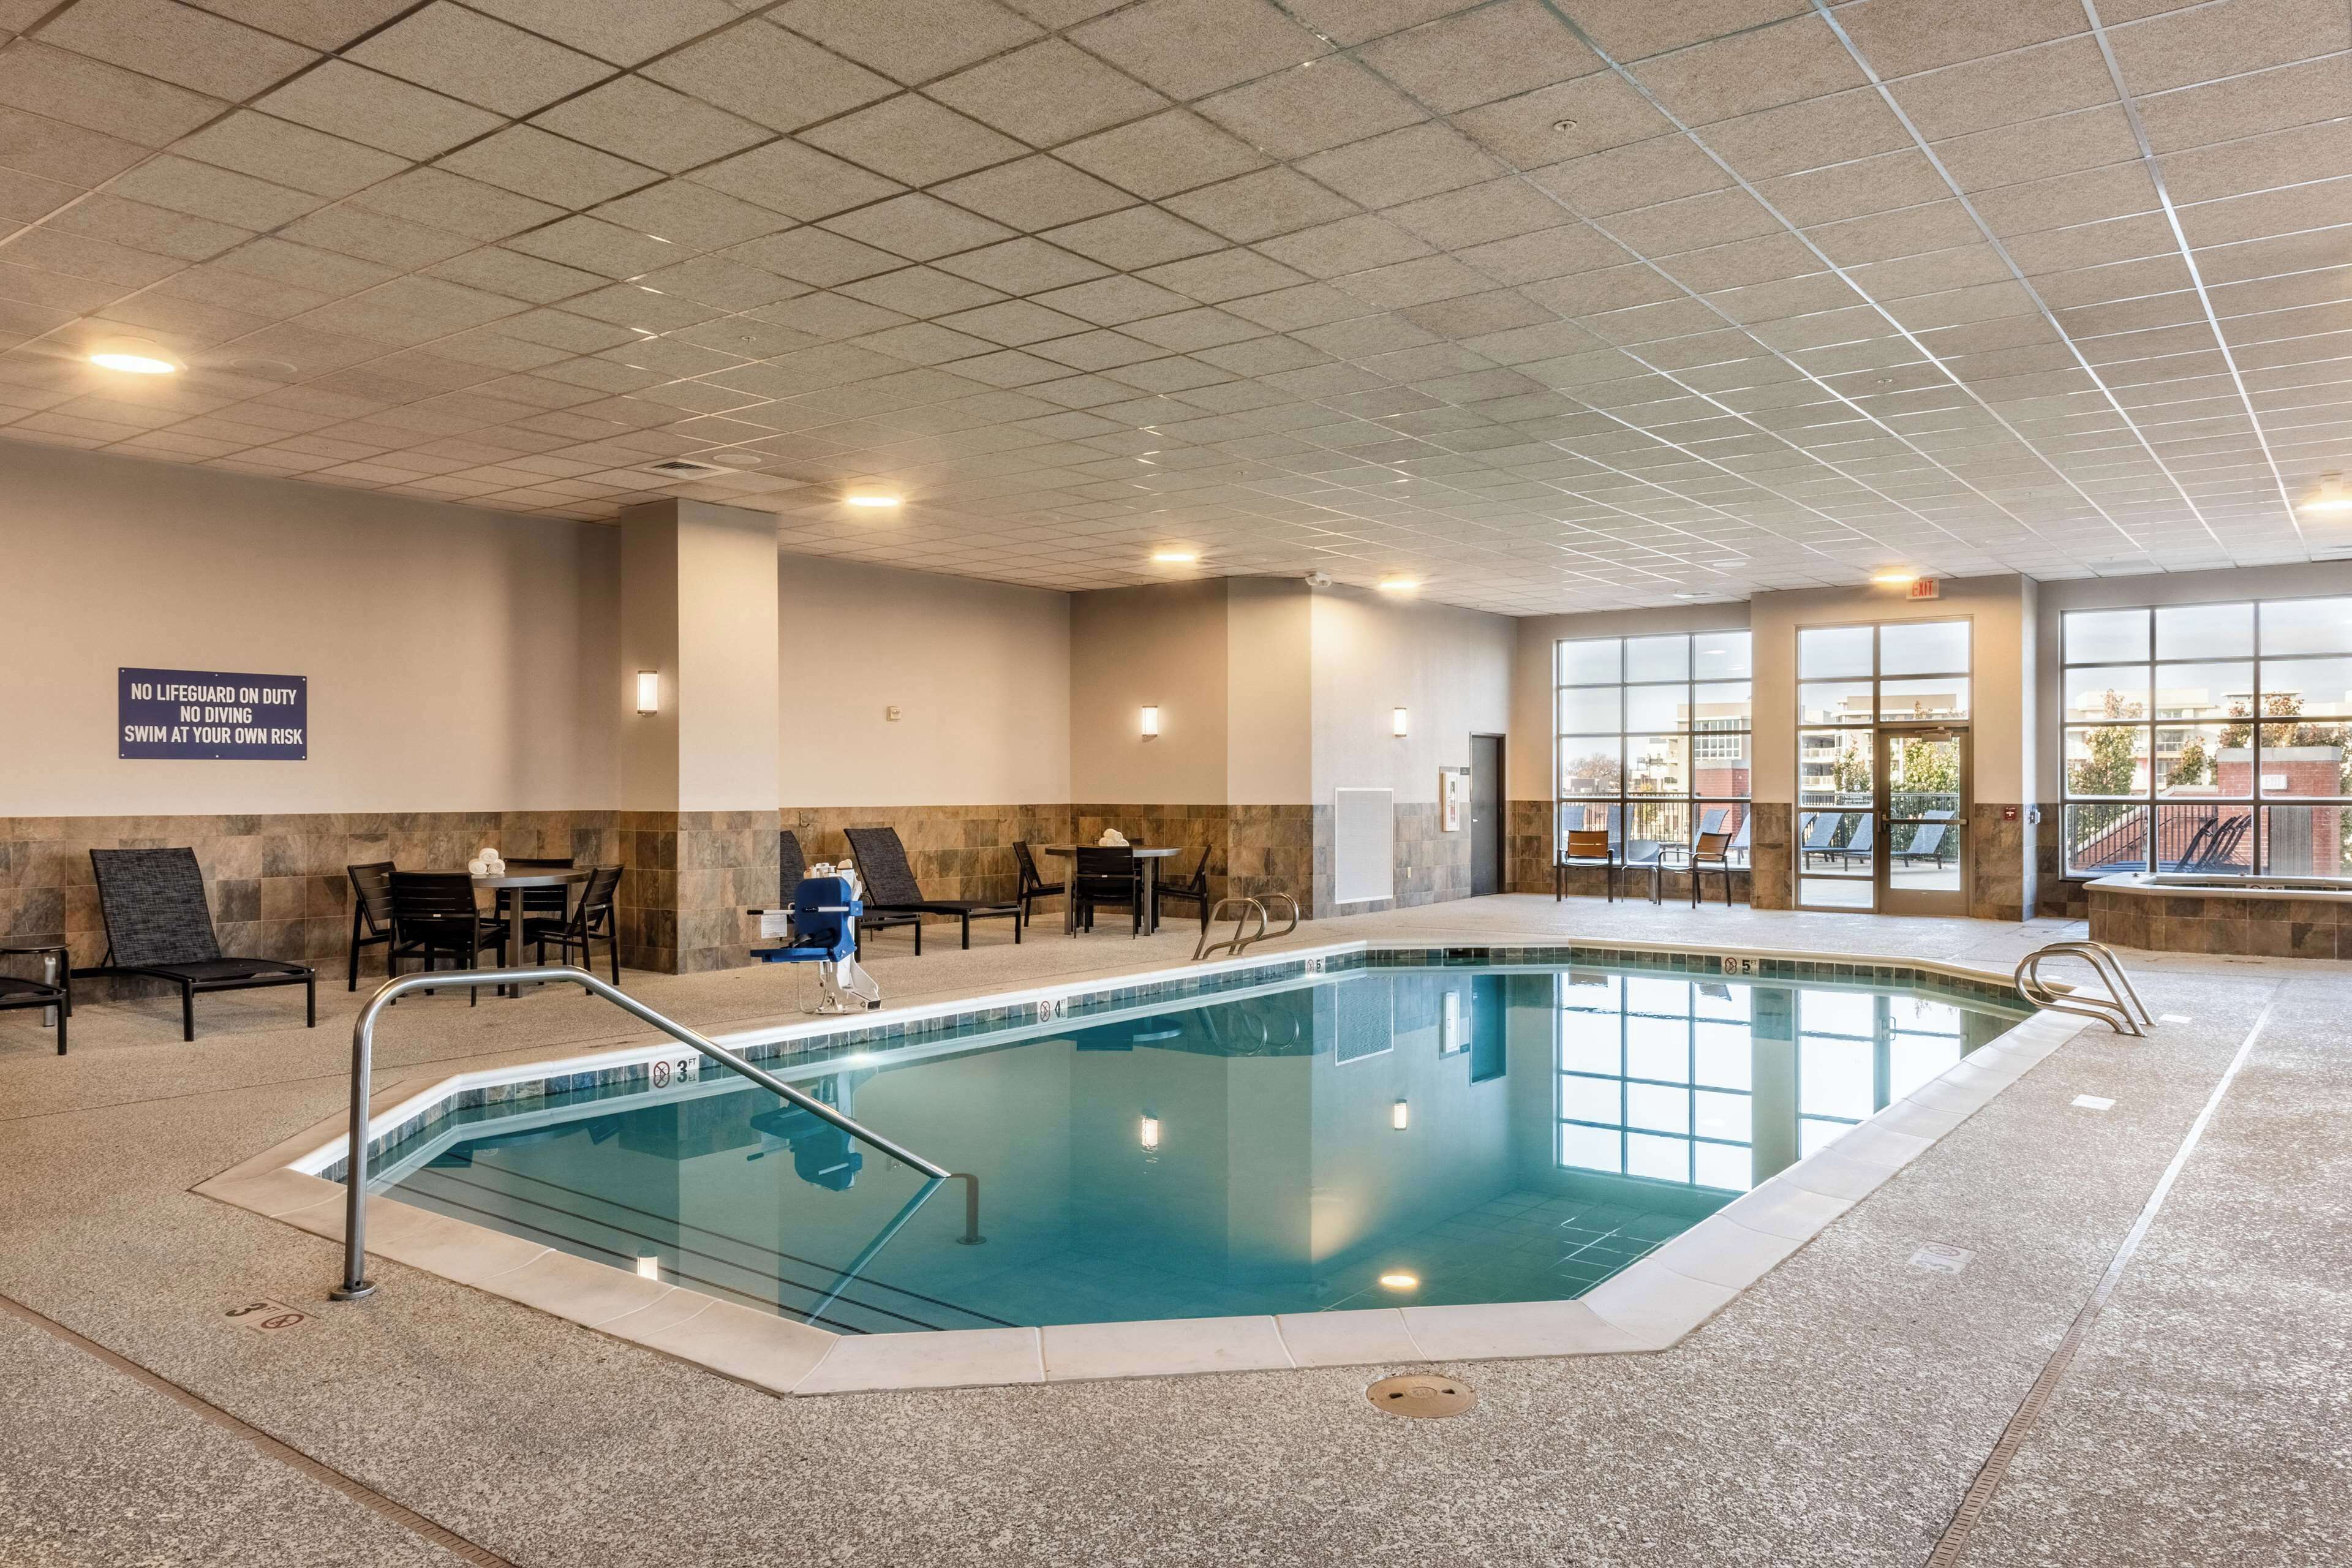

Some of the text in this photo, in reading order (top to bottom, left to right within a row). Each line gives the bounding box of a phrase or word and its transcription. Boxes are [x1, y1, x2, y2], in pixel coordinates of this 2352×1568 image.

[1911, 579, 1934, 597] EXIT
[131, 683, 297, 705] NO LIFEGUARD ON DUTY
[181, 706, 252, 724] NO DIVING
[124, 725, 303, 745] SWIM AT YOUR OWN RISK
[1742, 959, 1751, 971] 5
[677, 1058, 696, 1072] 3 FT
[225, 1302, 268, 1317] 3
